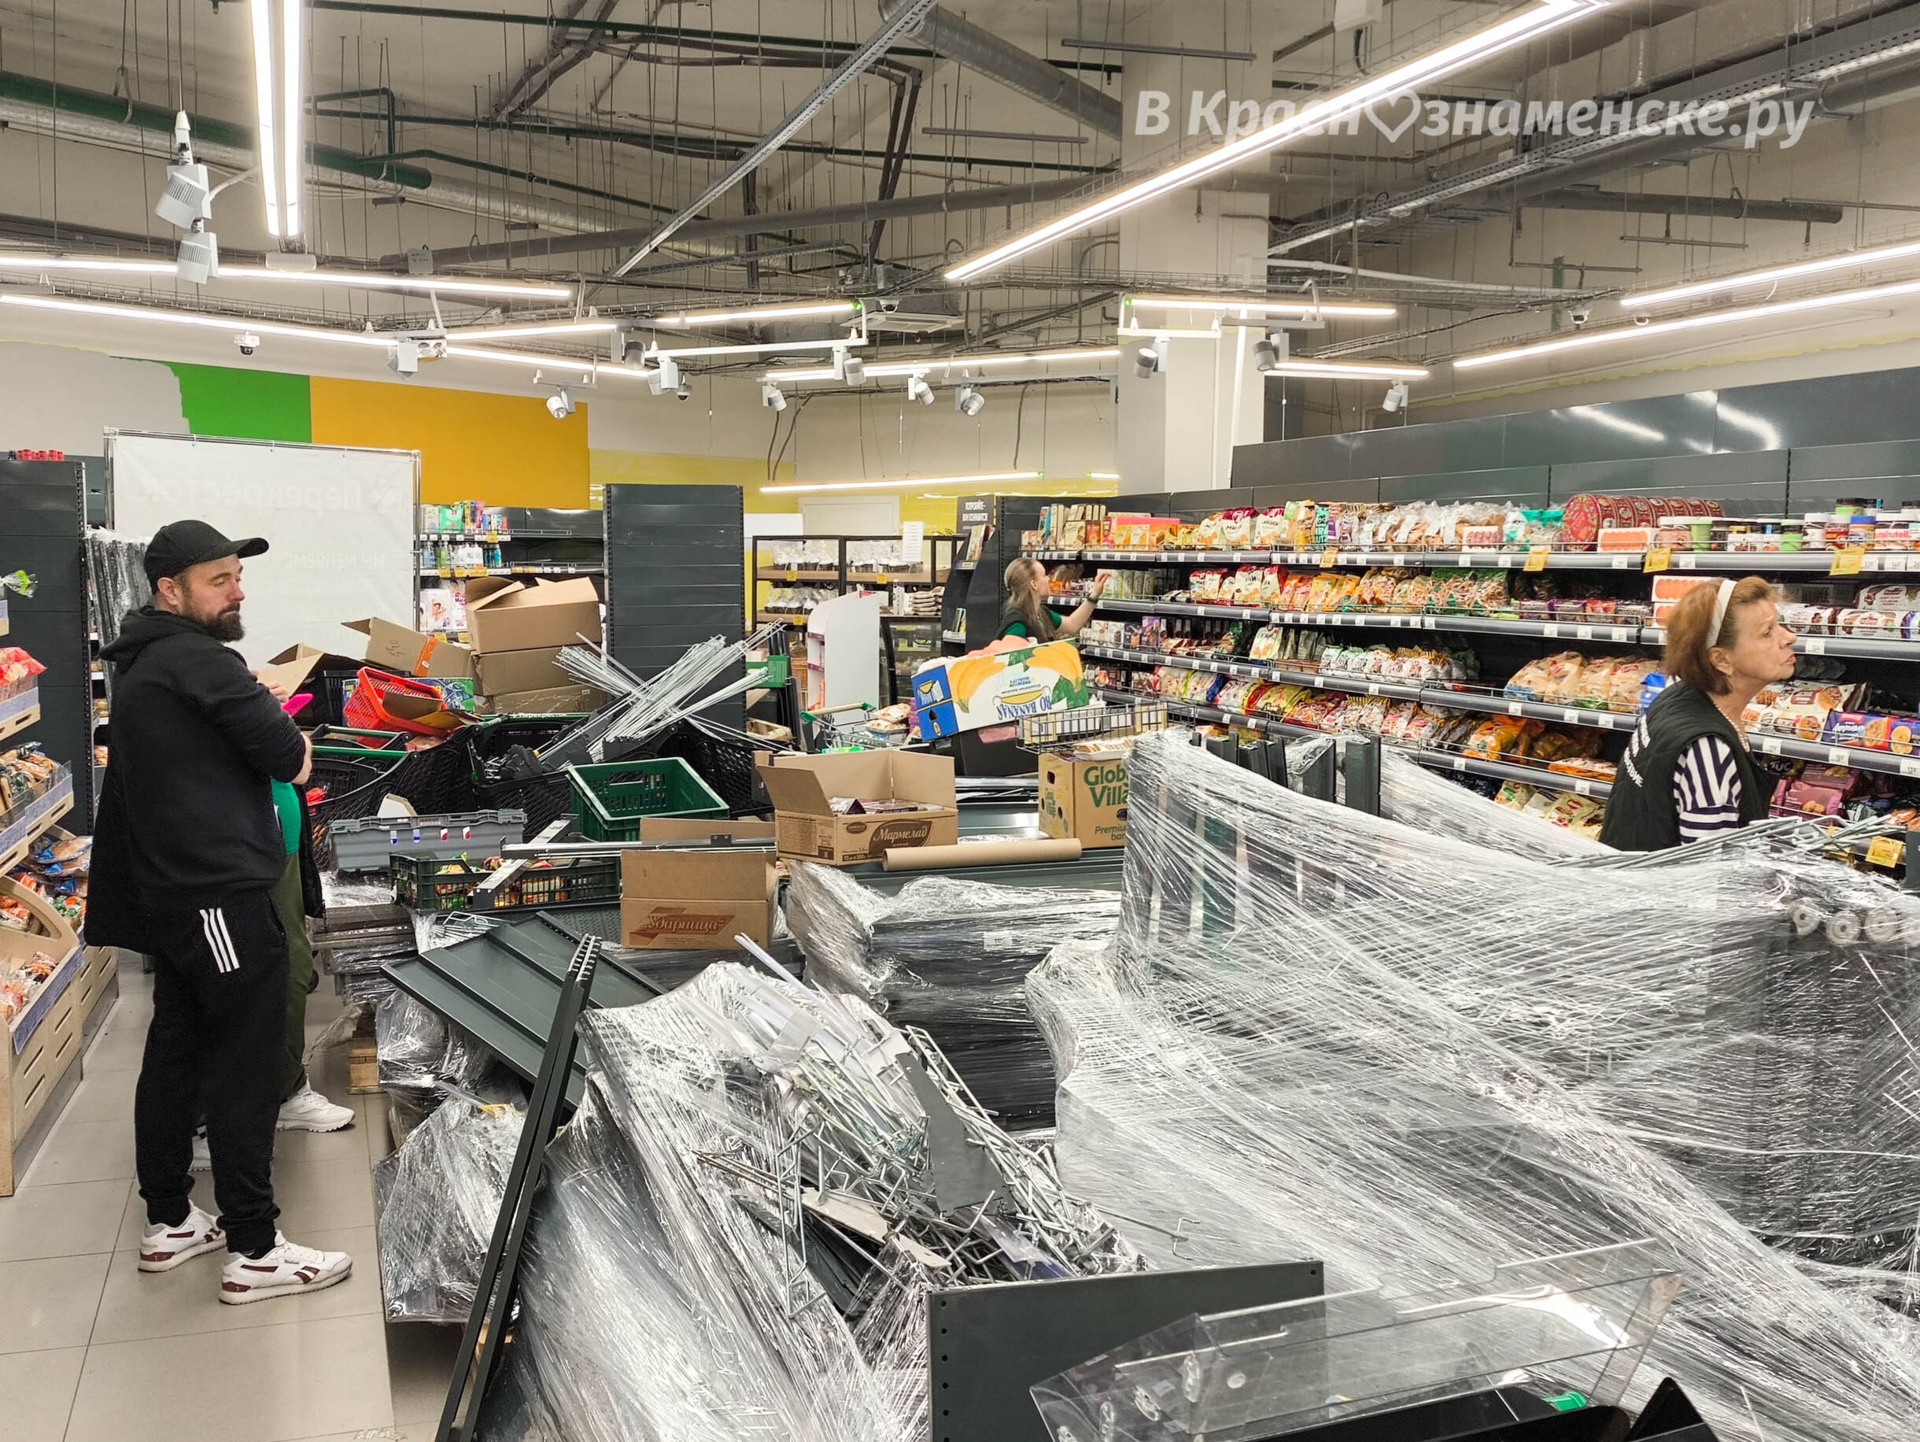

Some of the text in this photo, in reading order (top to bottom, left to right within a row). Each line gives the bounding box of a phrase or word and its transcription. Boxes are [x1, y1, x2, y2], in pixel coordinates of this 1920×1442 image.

[996, 701, 1038, 721] BANANAS
[1083, 763, 1130, 787] Glob
[1769, 760, 1792, 772] TUC
[872, 825, 928, 844] Мармелад
